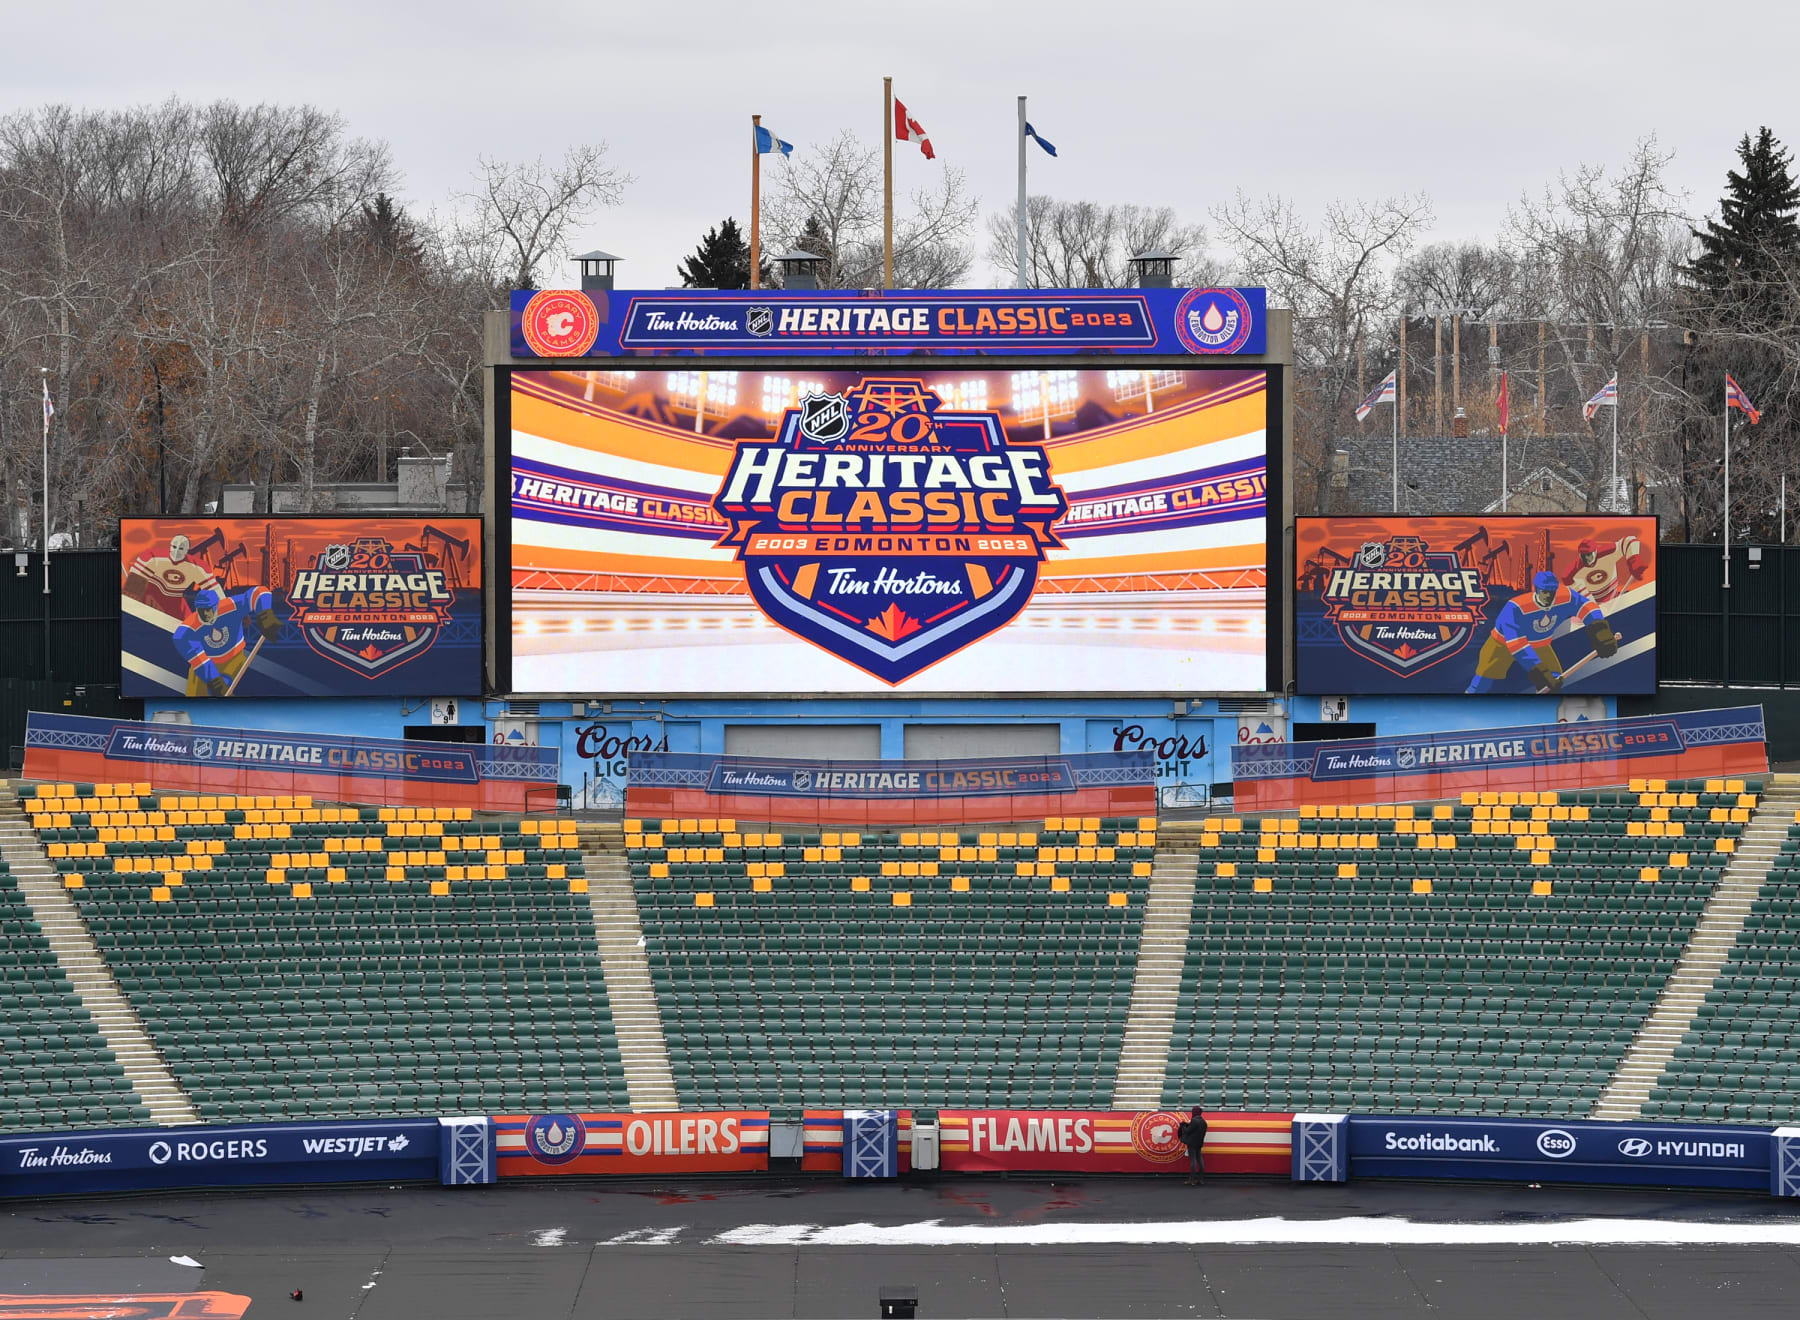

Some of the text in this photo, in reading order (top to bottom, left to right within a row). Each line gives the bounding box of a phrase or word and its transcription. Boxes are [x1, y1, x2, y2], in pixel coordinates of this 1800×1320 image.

[540, 301, 582, 319] CALGARY
[777, 307, 1133, 333] HERITAGE CLASSIC 2023
[646, 311, 738, 331] Tim Hortons
[541, 330, 581, 347] FLAMES
[810, 404, 841, 431] NHL
[833, 444, 952, 453] ANNIVERSARY
[721, 447, 1060, 506] HERITAGE
[518, 477, 639, 514] HERITAGE
[777, 490, 1016, 524] CLASSIC
[1067, 493, 1168, 522] HERITAGE
[755, 537, 1029, 552] 2003 EDMONTON 2023
[291, 572, 450, 600] HERITAGE
[827, 566, 963, 596] Tim Hortons
[1327, 570, 1485, 598] HERITAGE
[316, 592, 429, 609] CLASSIC
[1351, 591, 1463, 607] CLASSIC
[334, 613, 407, 621] EDMONTON
[1370, 612, 1442, 620] EDMONTON
[341, 627, 402, 641] Tim Hortons
[1376, 626, 1438, 640] Tim Hortons
[443, 715, 449, 724] 9
[1331, 712, 1340, 722] 10
[123, 736, 188, 754] Tim Hortons
[1419, 732, 1669, 765] HERITAGE CLASSIC 2023
[215, 740, 465, 771] HERITAGE CLASSIC 2023
[1326, 754, 1392, 770] Tim Hortons
[723, 771, 787, 787] Tim Hortons
[814, 770, 1062, 790] HERITAGE CLASSIC 2023
[626, 1117, 740, 1156] OILERS
[971, 1117, 1094, 1153] FLAMES
[1384, 1131, 1496, 1153] Scotiabank
[1542, 1136, 1570, 1150] Esso
[177, 1139, 268, 1162] ROGERS
[302, 1136, 387, 1157] WESTJET
[1657, 1140, 1745, 1158] HYUNDAI
[19, 1146, 112, 1168] Tim Hortons
